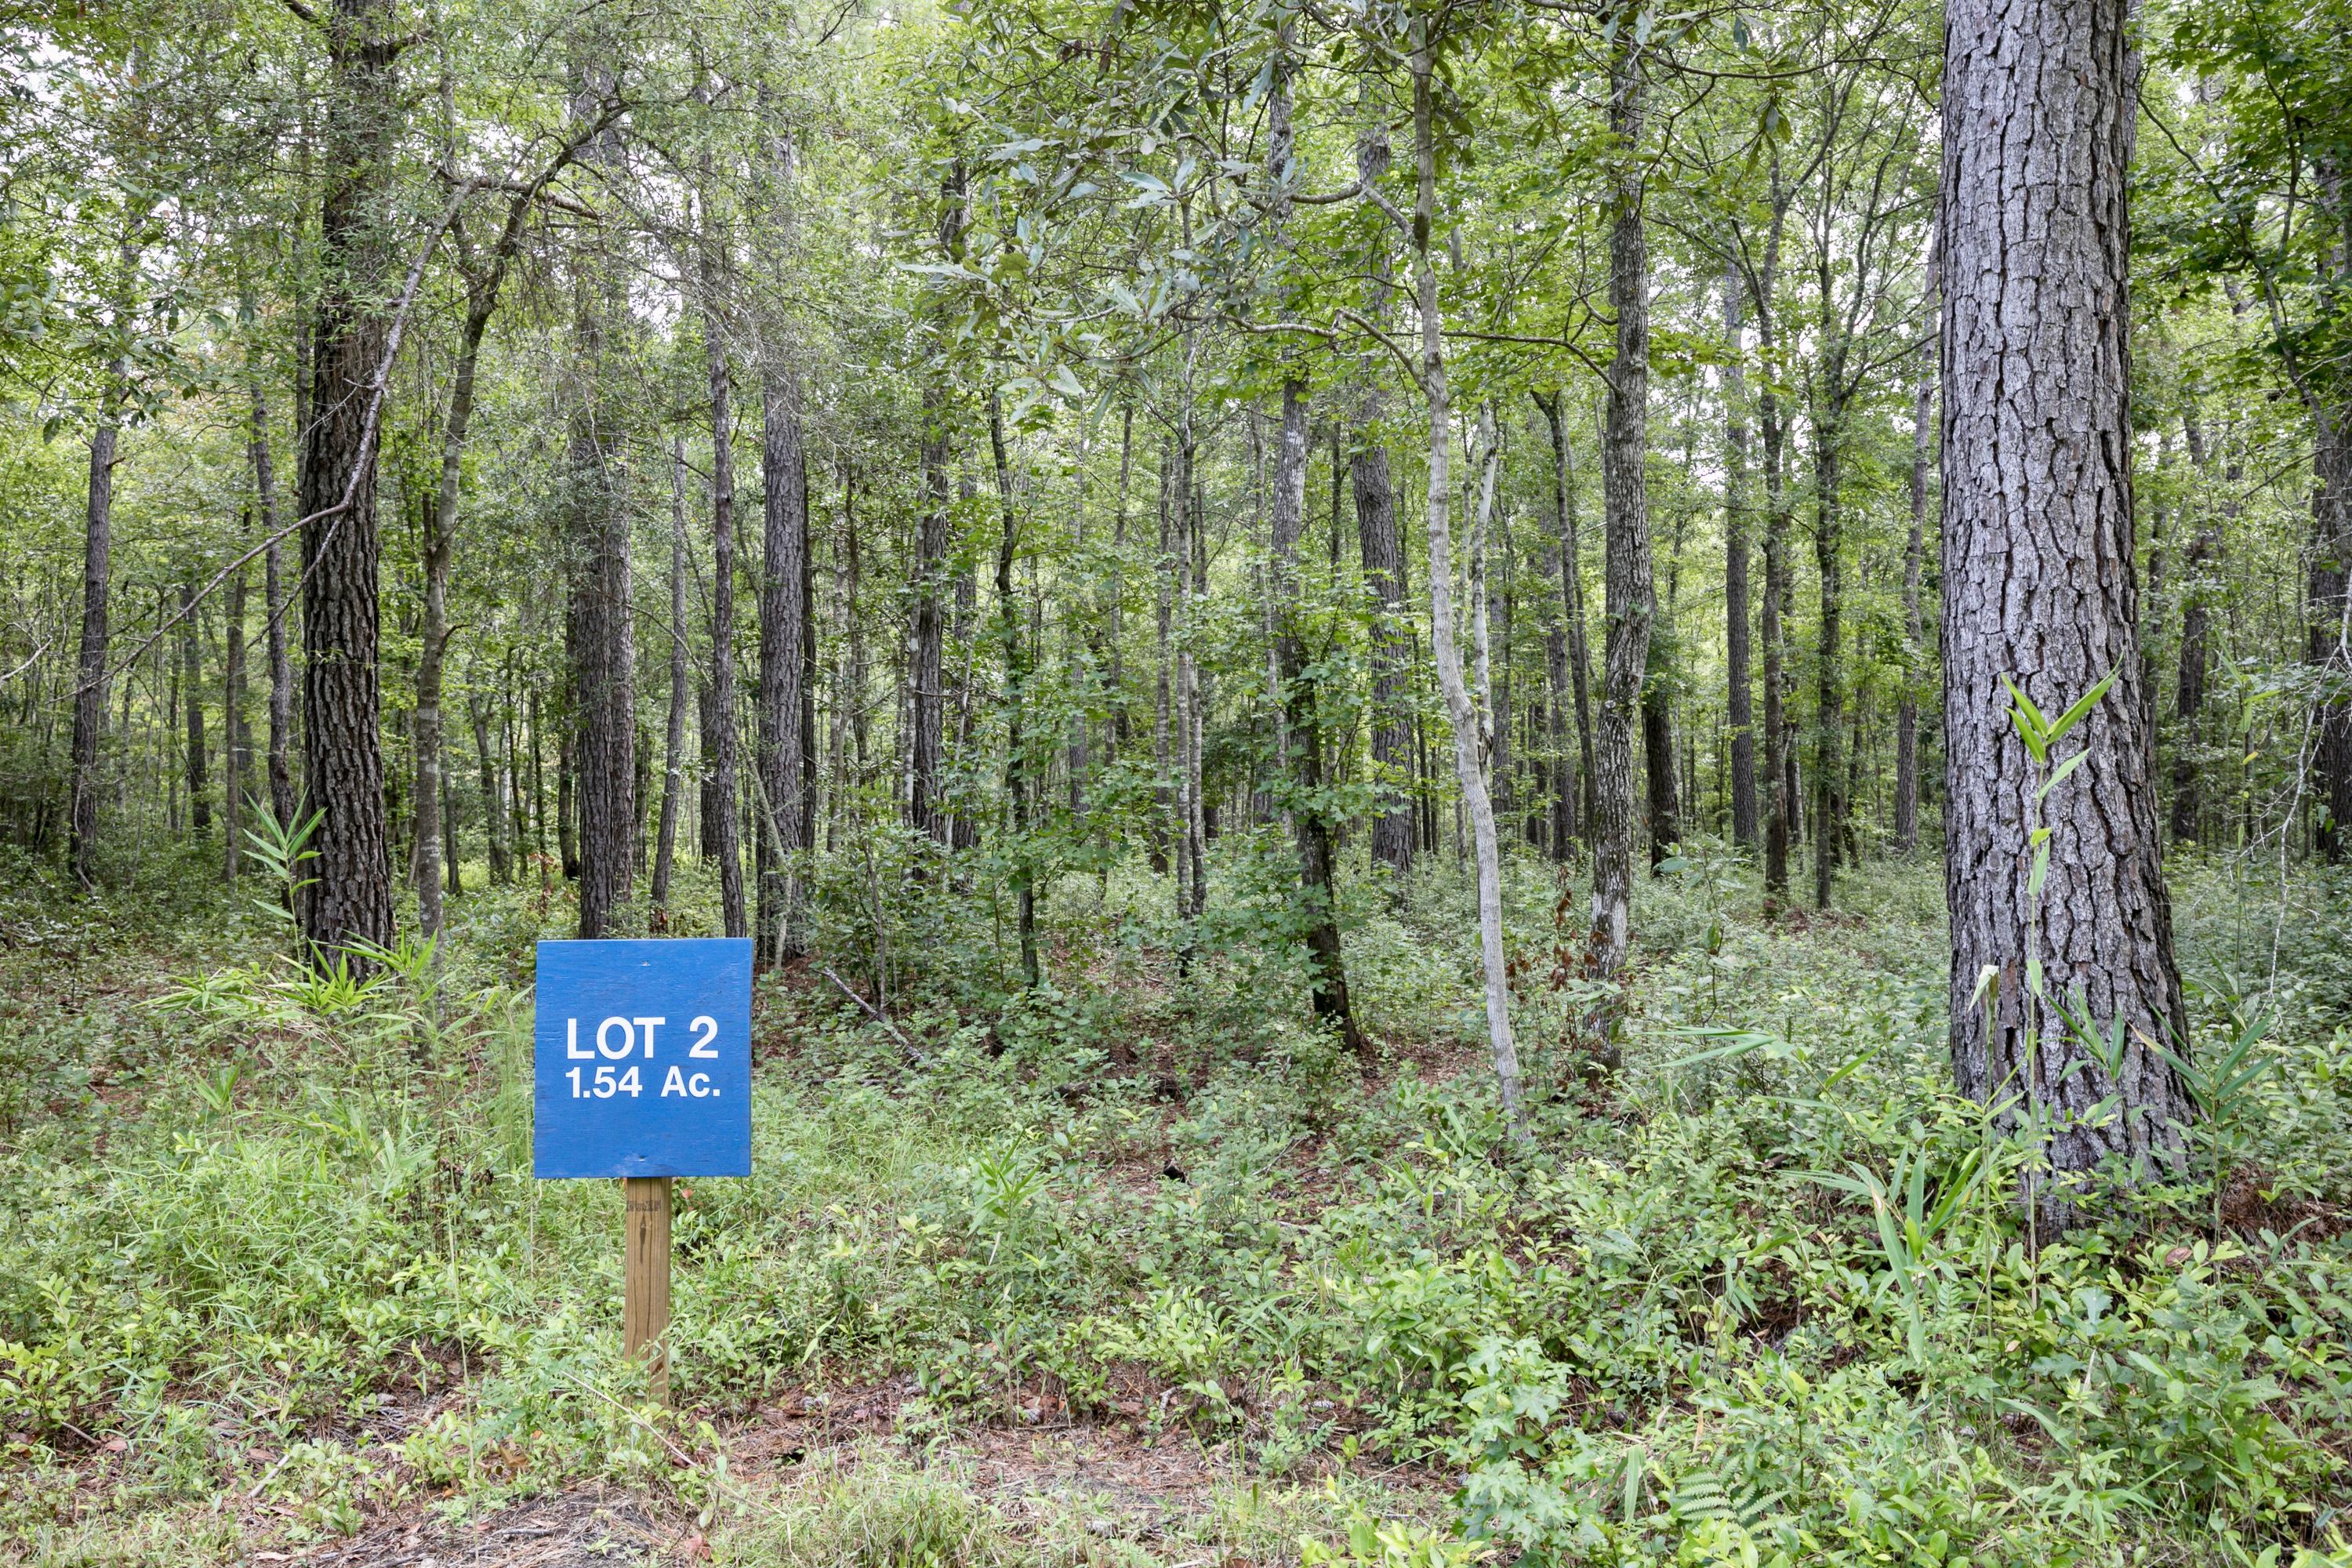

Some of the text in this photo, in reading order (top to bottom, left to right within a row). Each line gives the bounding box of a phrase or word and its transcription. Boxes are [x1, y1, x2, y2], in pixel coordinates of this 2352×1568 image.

[568, 1016, 719, 1060] LOT 2
[565, 1066, 720, 1098] 1.54 Ac.
